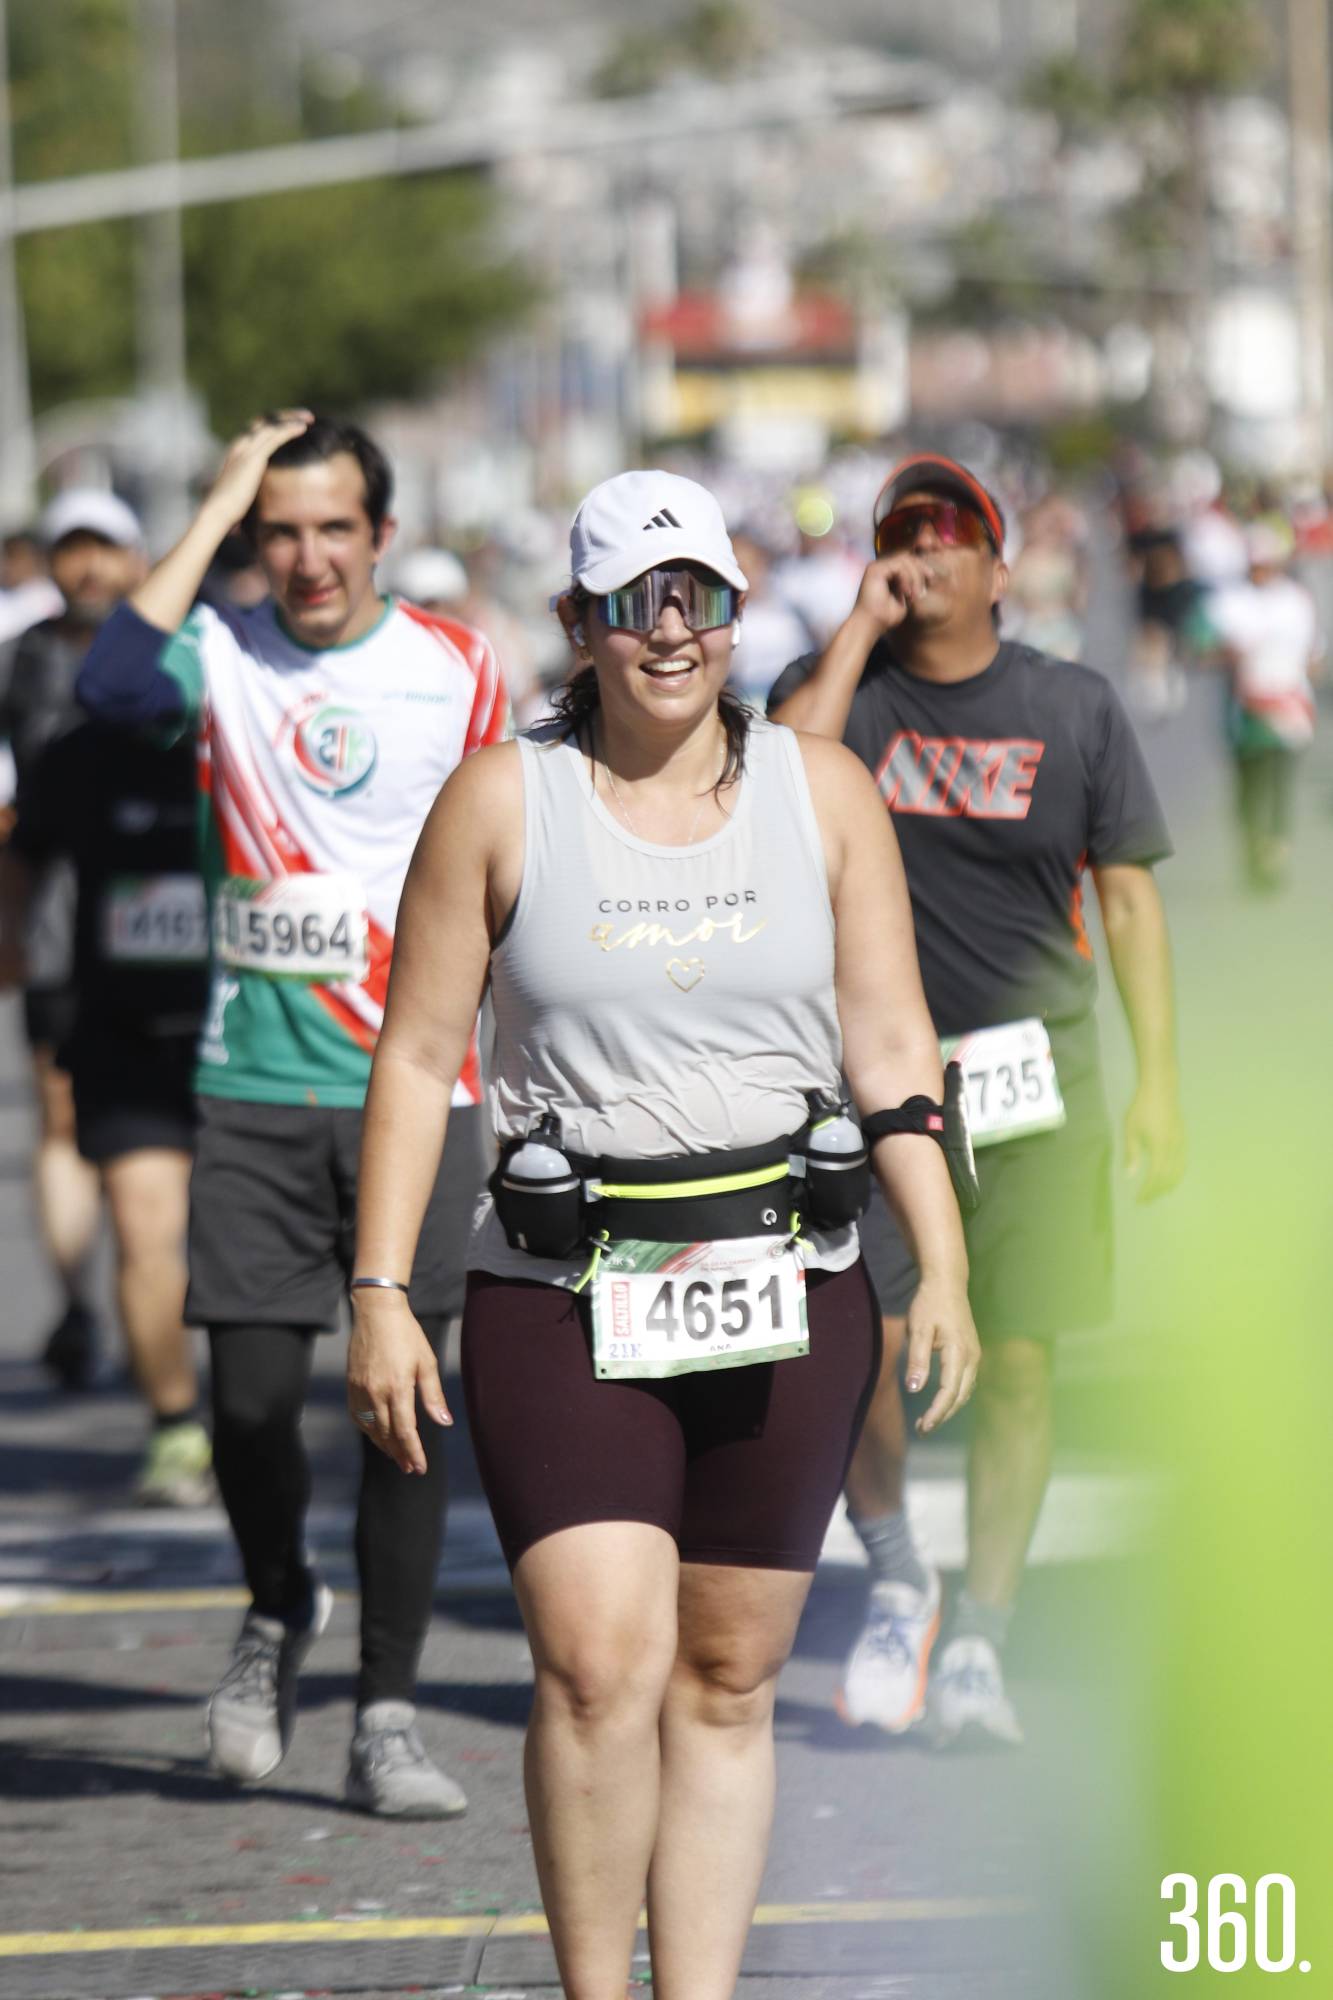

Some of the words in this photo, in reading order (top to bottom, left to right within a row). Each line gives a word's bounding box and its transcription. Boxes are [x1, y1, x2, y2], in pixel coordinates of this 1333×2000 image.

[875, 730, 1045, 820] NIKE
[599, 900, 690, 913] CORRO
[706, 890, 757, 909] POR
[248, 911, 353, 956] 5964
[590, 912, 769, 952] amor
[965, 1058, 1043, 1116] 735
[645, 1274, 783, 1342] 4651
[608, 1343, 643, 1359] 21K
